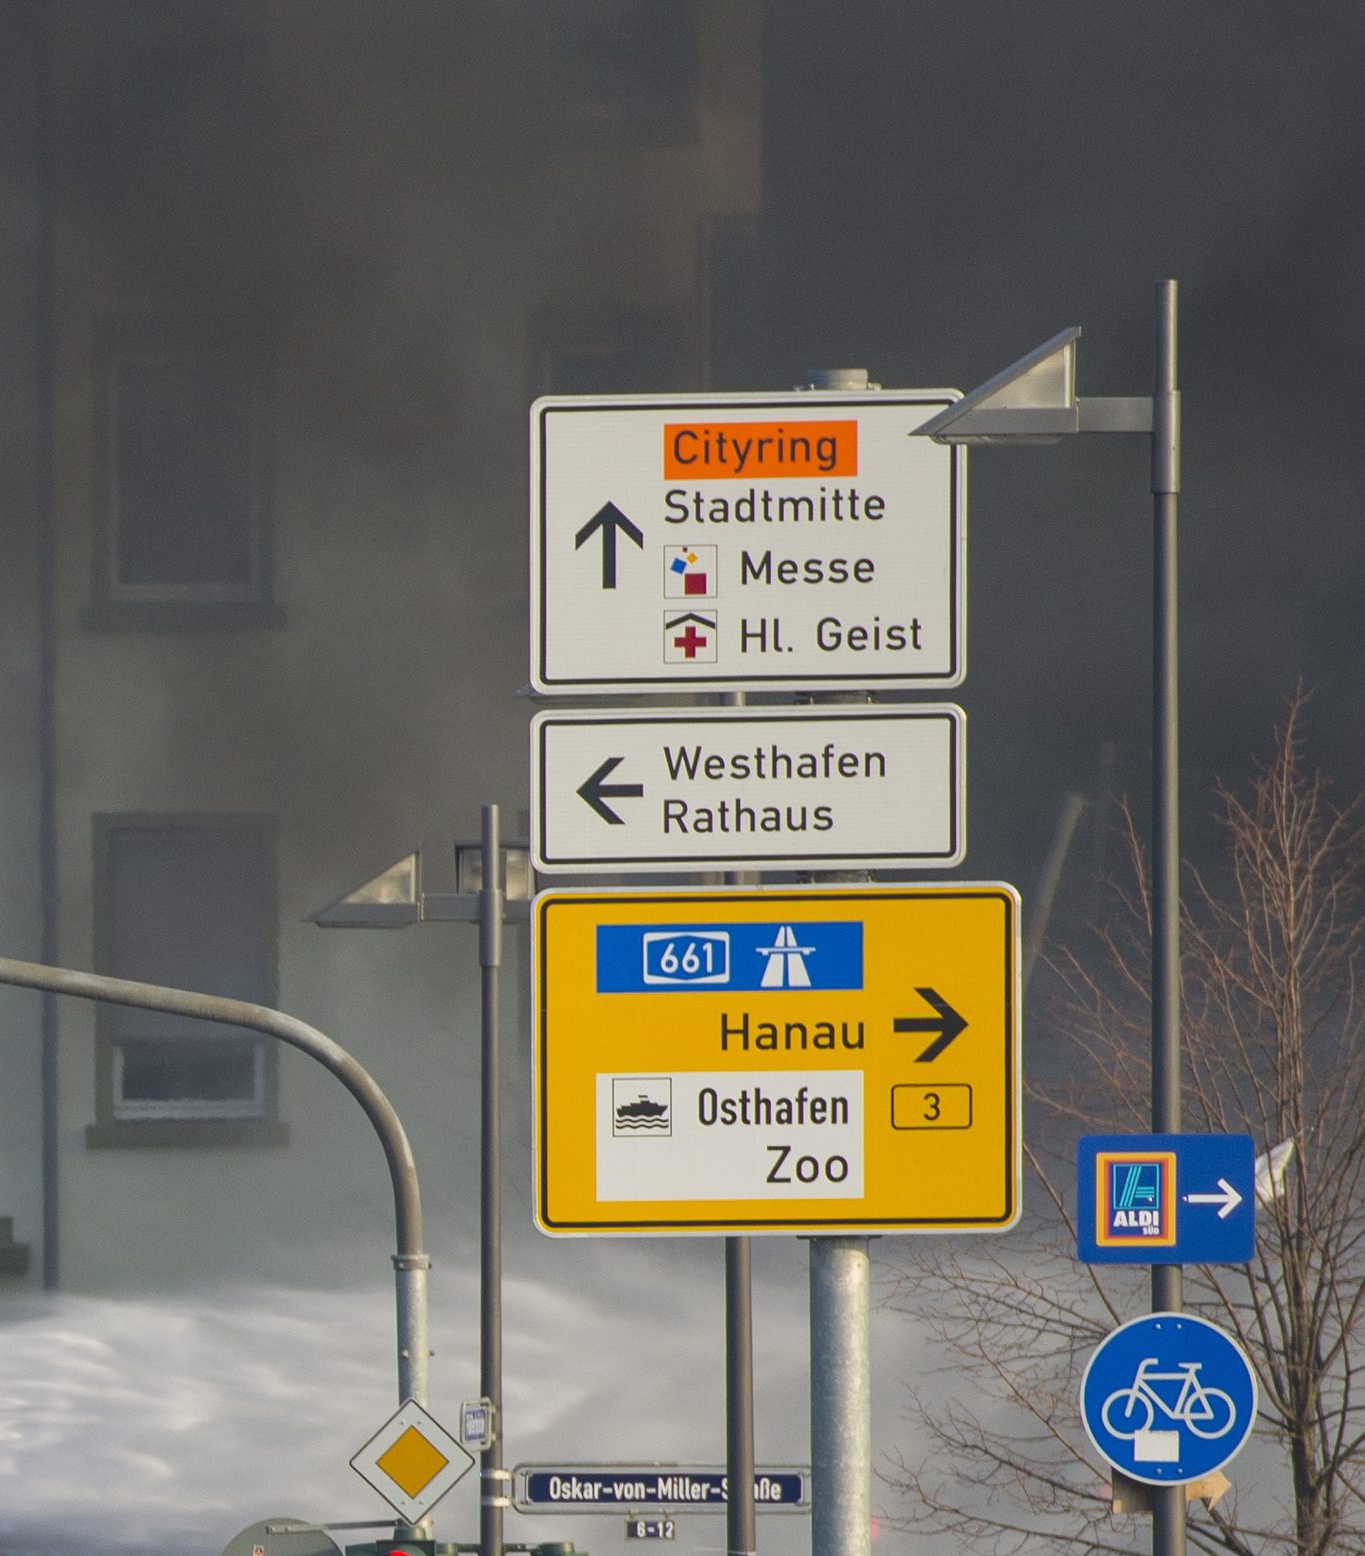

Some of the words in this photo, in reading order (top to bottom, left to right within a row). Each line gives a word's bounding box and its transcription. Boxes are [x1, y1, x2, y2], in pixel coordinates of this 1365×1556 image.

[673, 428, 837, 473] Cityring
[664, 487, 886, 524] Stadtmitte
[741, 551, 875, 585] Messe
[741, 618, 793, 653] Hl.
[816, 617, 922, 652] Geist
[663, 744, 886, 781] Westhafen
[663, 799, 834, 834] Rathaus
[660, 942, 713, 974] 661
[721, 1013, 865, 1051] Hanau
[698, 1087, 849, 1126] Osthafen
[923, 1092, 941, 1121] 3
[766, 1145, 849, 1184] Zoo
[1113, 1210, 1159, 1227] ALDI
[549, 1476, 782, 1501] Oskar-von-Miller-Sße
